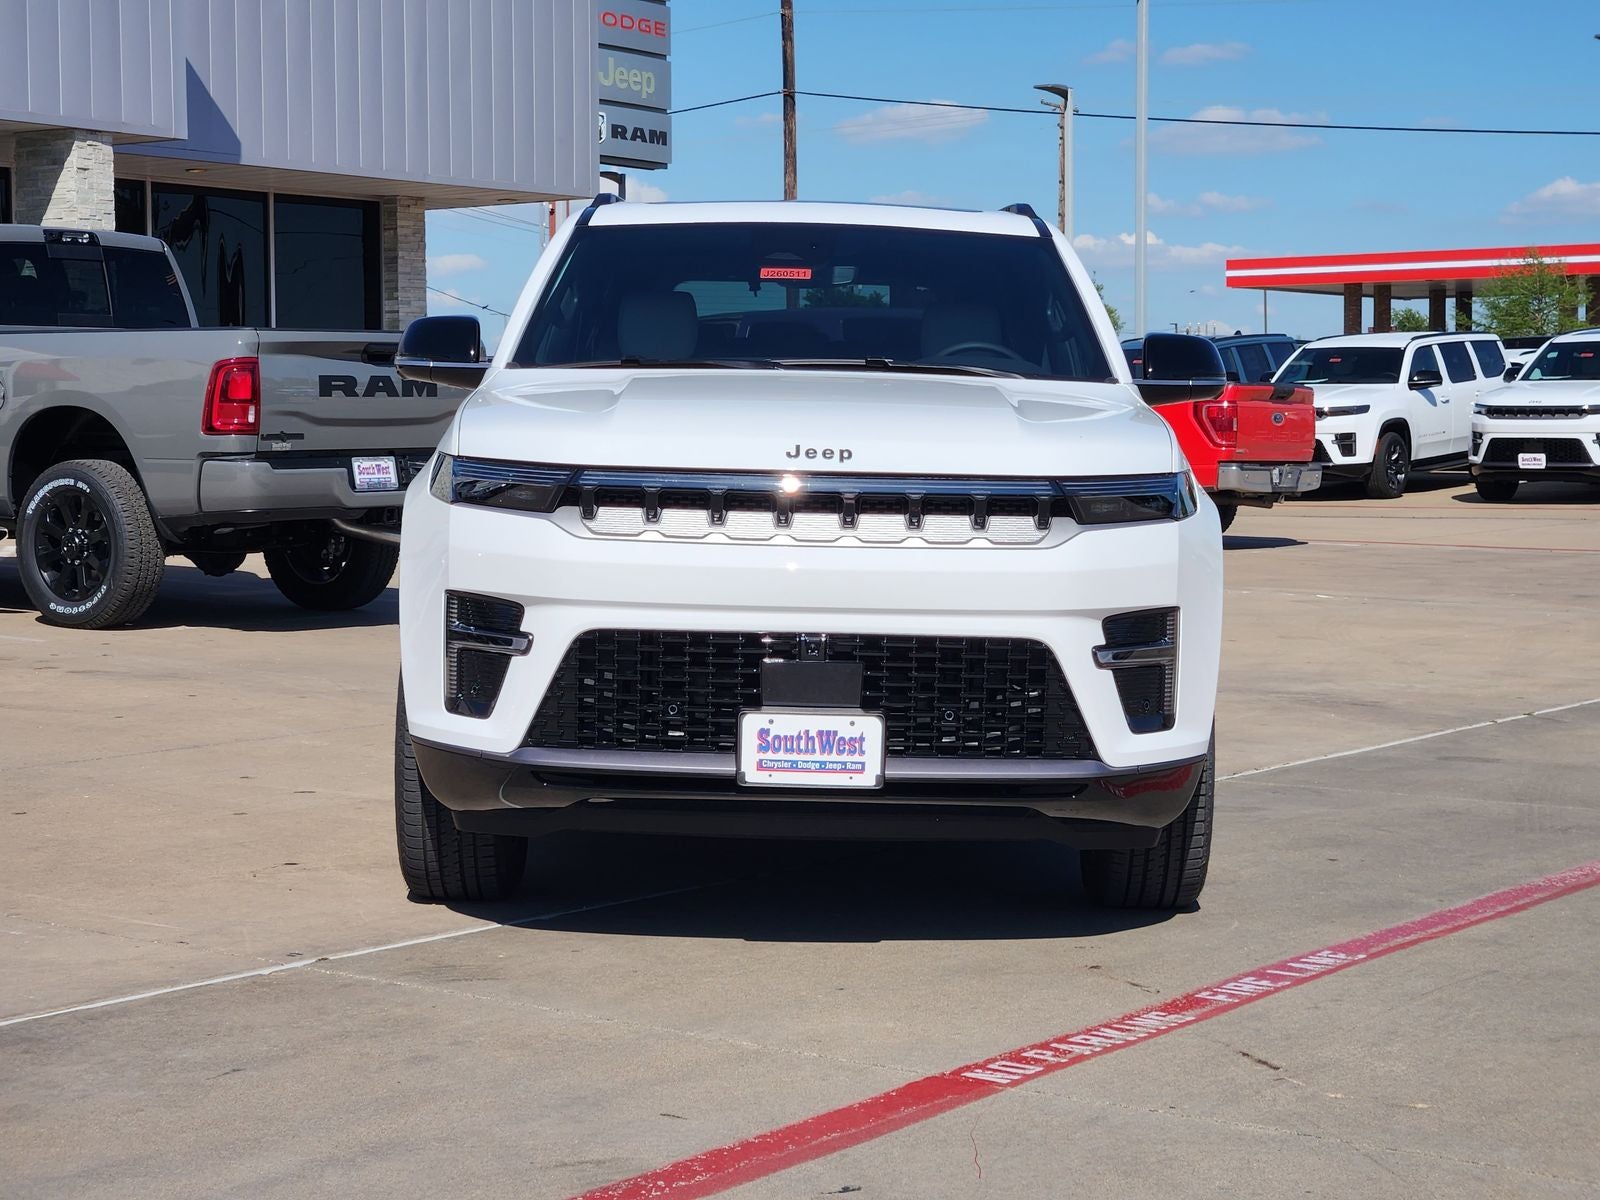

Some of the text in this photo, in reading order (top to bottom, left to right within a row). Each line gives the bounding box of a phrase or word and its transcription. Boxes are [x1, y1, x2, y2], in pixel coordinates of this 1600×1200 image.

[602, 11, 667, 38] ODGE
[598, 56, 655, 99] Jeep
[611, 123, 668, 146] RAM
[763, 270, 807, 278] J260511
[318, 375, 438, 398] RAM
[785, 444, 853, 463] Jeep
[756, 727, 866, 757] SouthWest
[762, 759, 862, 771] Chrysler Dodge Jeep Ram
[960, 1060, 1045, 1084] NO
[1195, 976, 1292, 1002] FIRE
[1265, 950, 1368, 977] LANE
